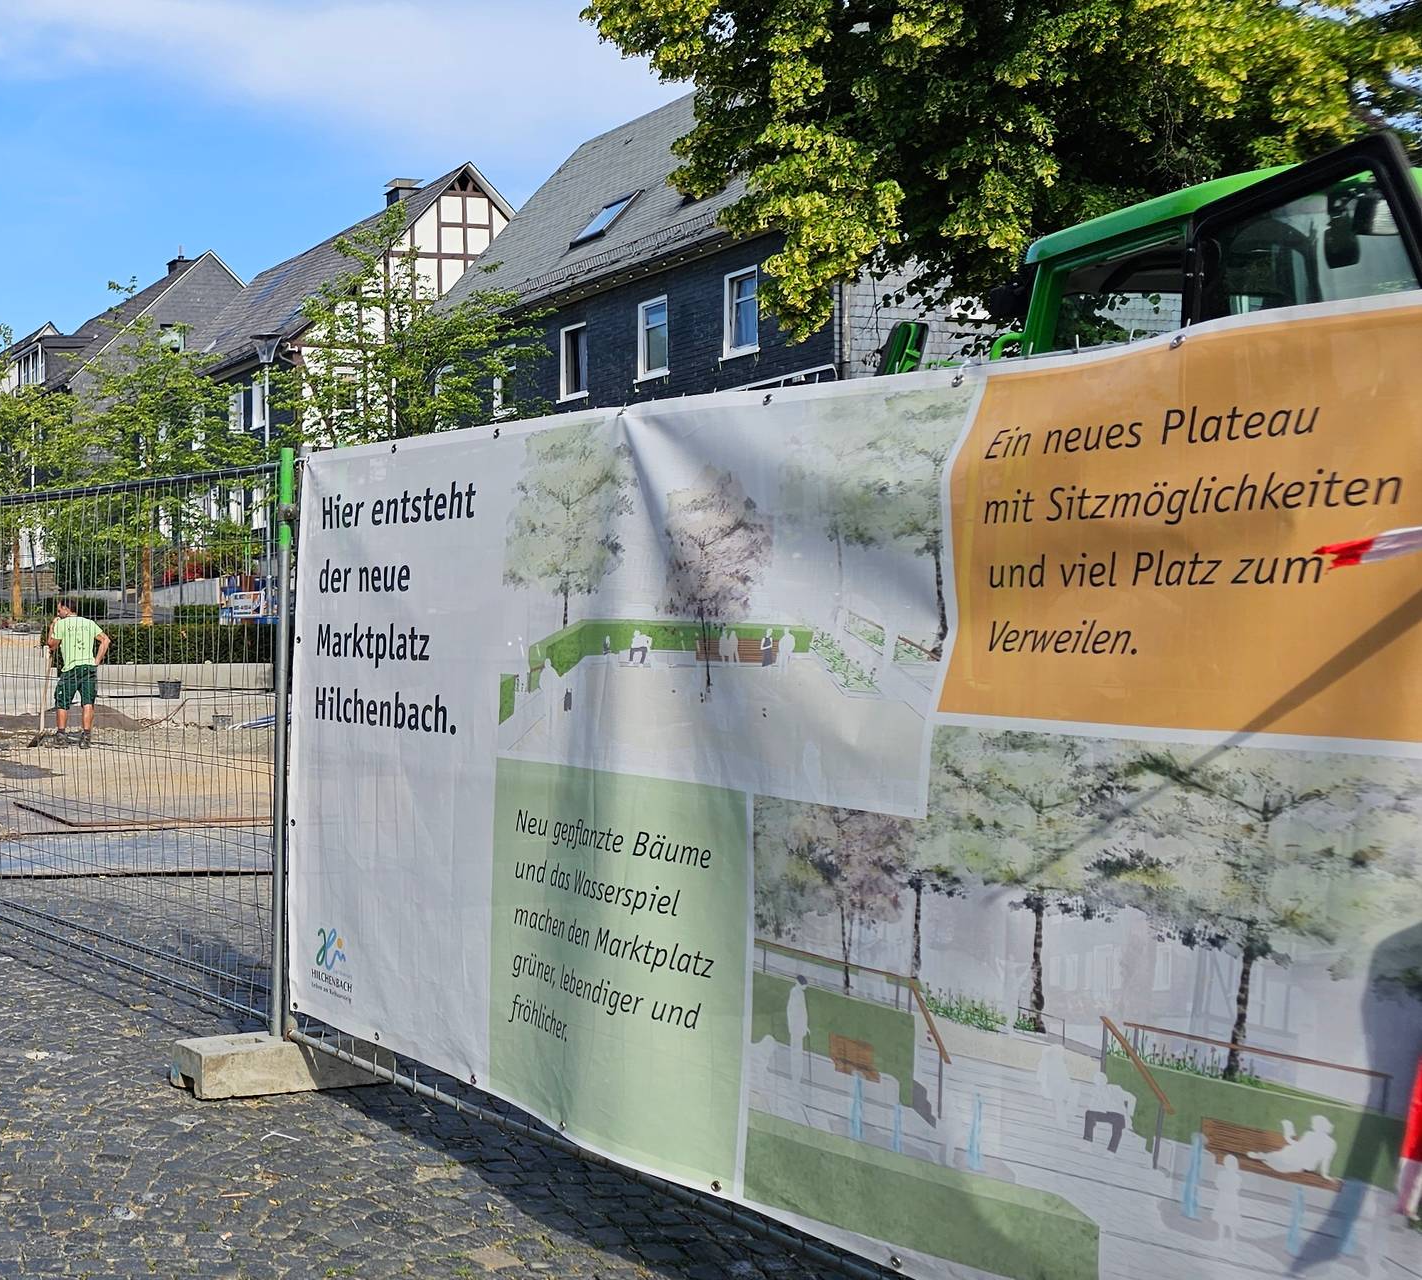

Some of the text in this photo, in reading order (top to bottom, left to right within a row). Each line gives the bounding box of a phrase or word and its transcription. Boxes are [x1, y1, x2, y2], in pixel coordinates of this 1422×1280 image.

[984, 405, 1321, 460] Ein neues Plateau
[322, 481, 477, 530] Hier entsteht
[984, 468, 1403, 525] mit Sitzmöglichkeiten
[319, 559, 411, 593] der neue
[989, 550, 1324, 588] und viel Platz zum
[317, 623, 431, 669] Marktplatz
[988, 619, 1138, 655] Verweilen.
[315, 686, 457, 735] Hilchenbach.
[515, 809, 712, 869] Neu gepflanzte Bäume
[515, 859, 681, 917] und das Wasserspiel
[514, 907, 715, 979] machen den Marktplatz
[311, 968, 353, 993] HILCHENBACH
[512, 953, 702, 1030] grüner, lebendiger und
[508, 993, 568, 1042] fröhlicher.
